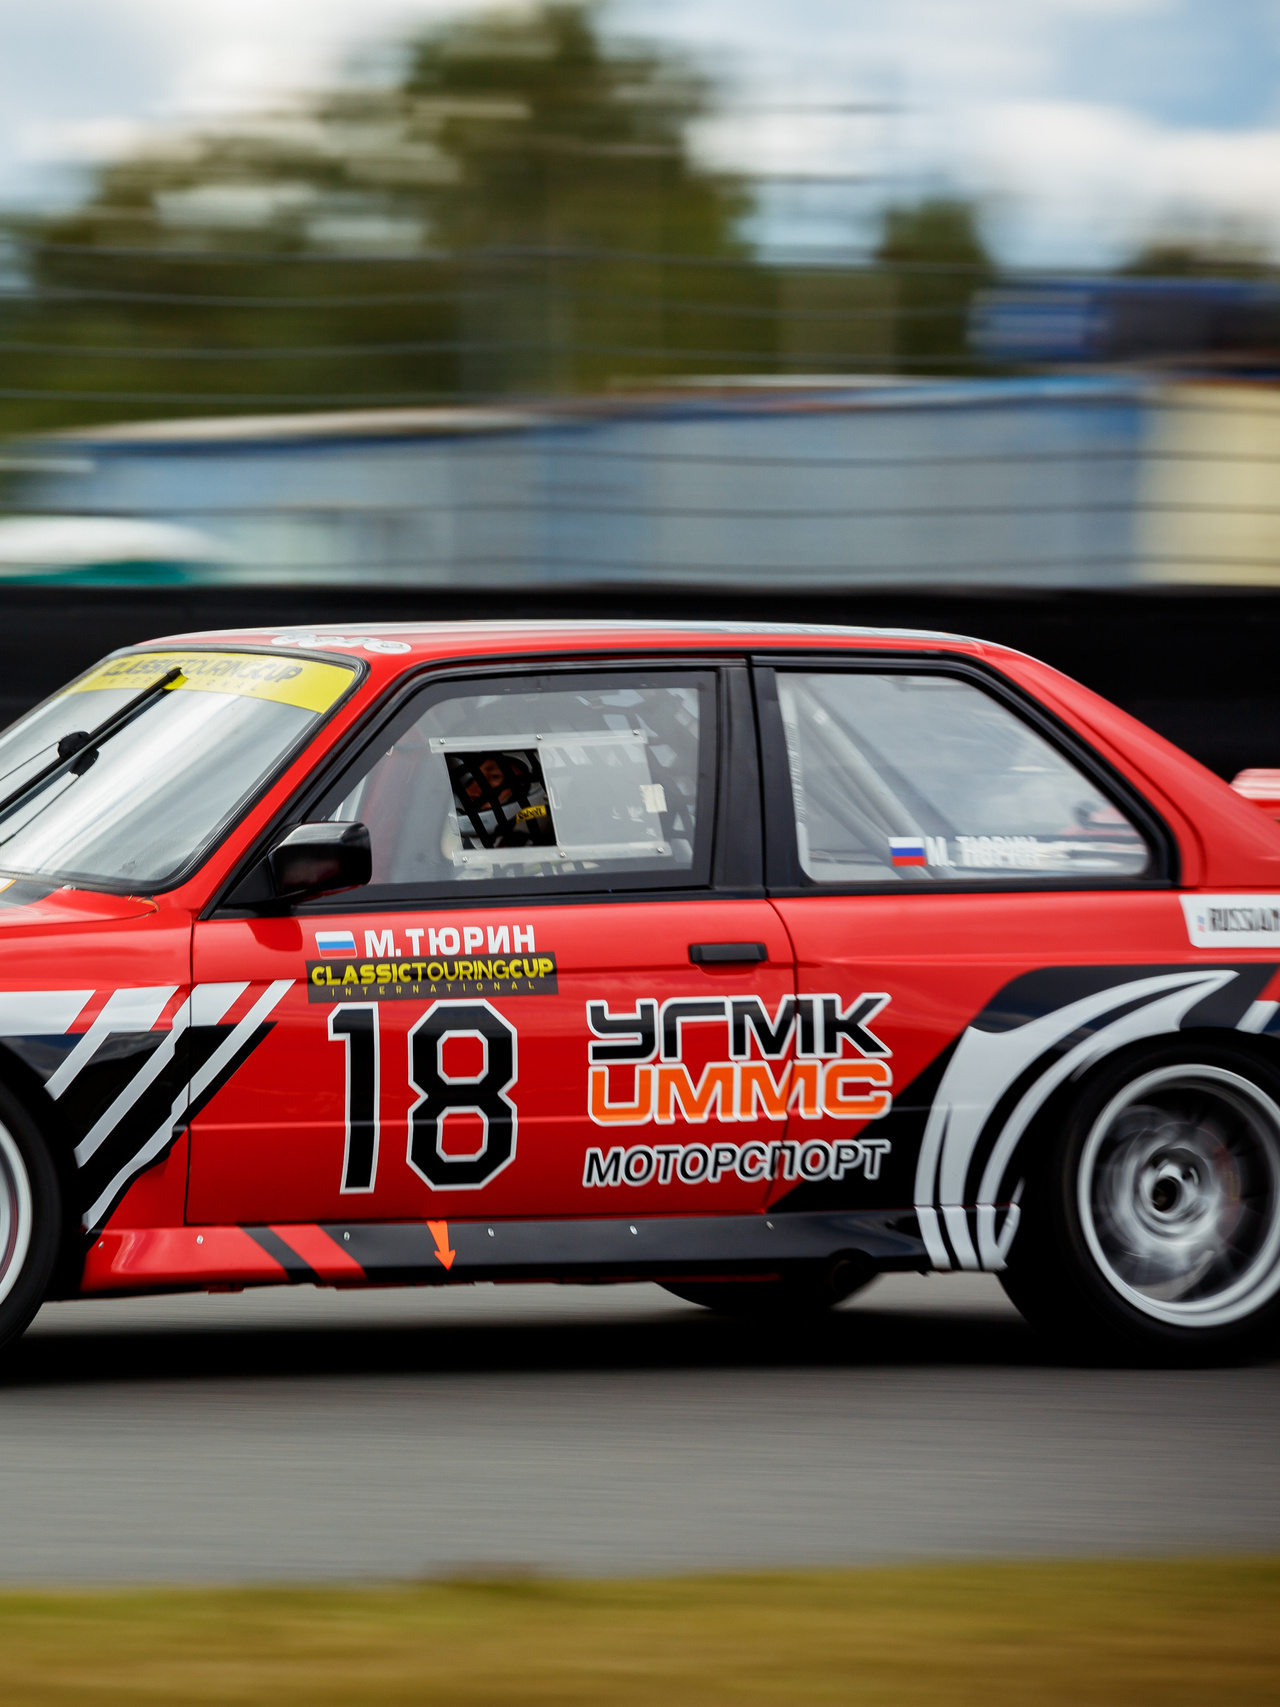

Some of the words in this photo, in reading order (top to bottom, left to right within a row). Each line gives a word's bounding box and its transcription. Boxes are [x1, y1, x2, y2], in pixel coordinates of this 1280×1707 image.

[311, 957, 554, 986] CLASSICTOURINGCUP
[331, 980, 535, 997] INTERNATIONAL
[586, 993, 894, 1064] УГМК
[327, 999, 519, 1195] 18
[587, 1060, 894, 1126] UMMC
[582, 1140, 892, 1188] МОТОРСПОРТ
